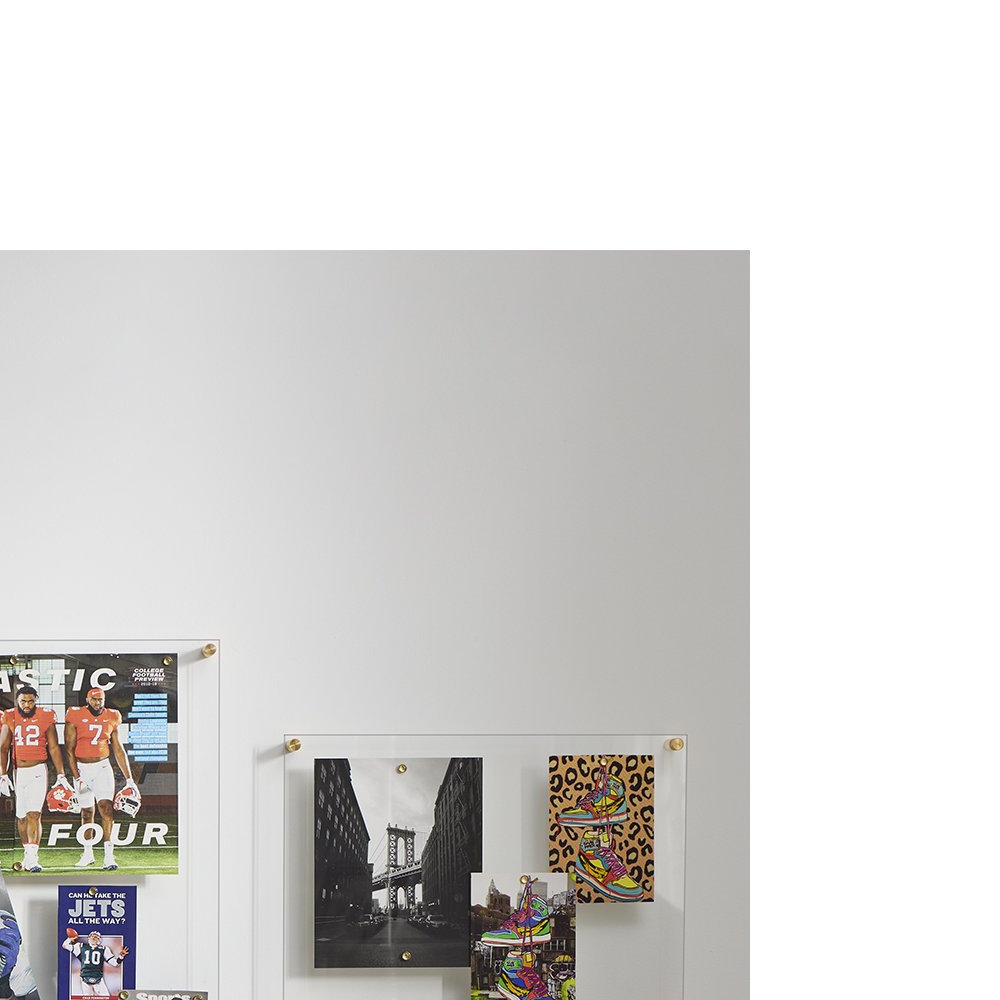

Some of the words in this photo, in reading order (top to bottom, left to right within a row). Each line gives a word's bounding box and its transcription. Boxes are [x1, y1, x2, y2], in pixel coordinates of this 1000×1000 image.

[14, 725, 40, 746] 42
[89, 724, 103, 745] 7
[47, 823, 169, 846] FOUR
[68, 899, 125, 918] JETS
[84, 950, 101, 965] 10
